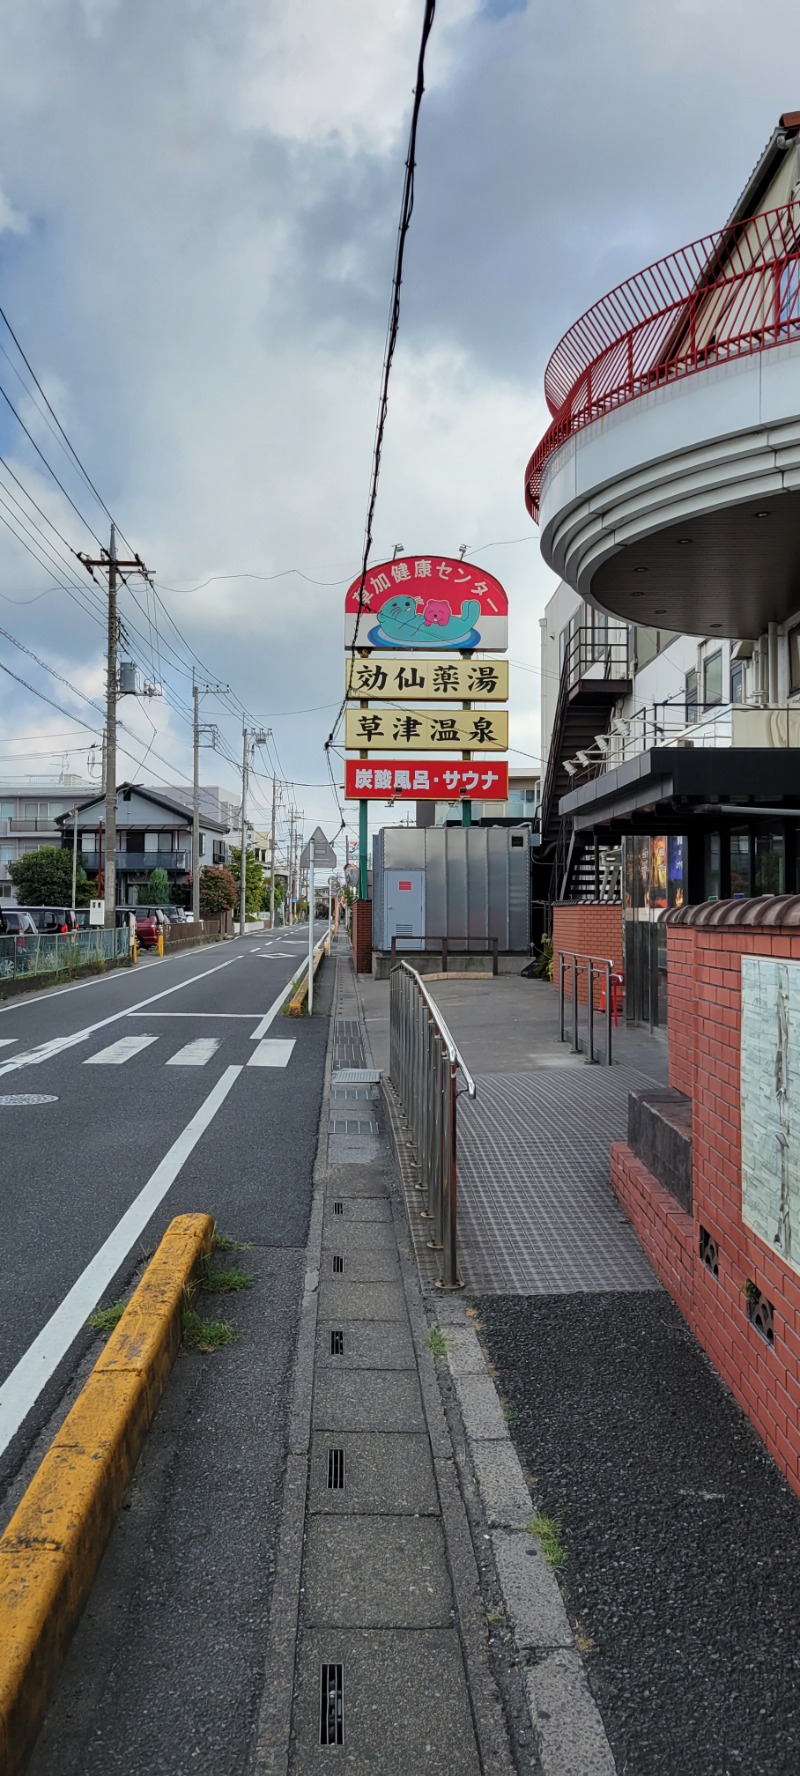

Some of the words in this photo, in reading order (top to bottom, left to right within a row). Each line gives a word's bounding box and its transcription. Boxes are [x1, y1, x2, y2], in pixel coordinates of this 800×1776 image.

[352, 560, 498, 612] 草加健康センター
[356, 665, 499, 693] 効仙薬湯
[356, 715, 499, 743] 草津温泉
[355, 769, 499, 790] 炭酸風呂・サウナ
